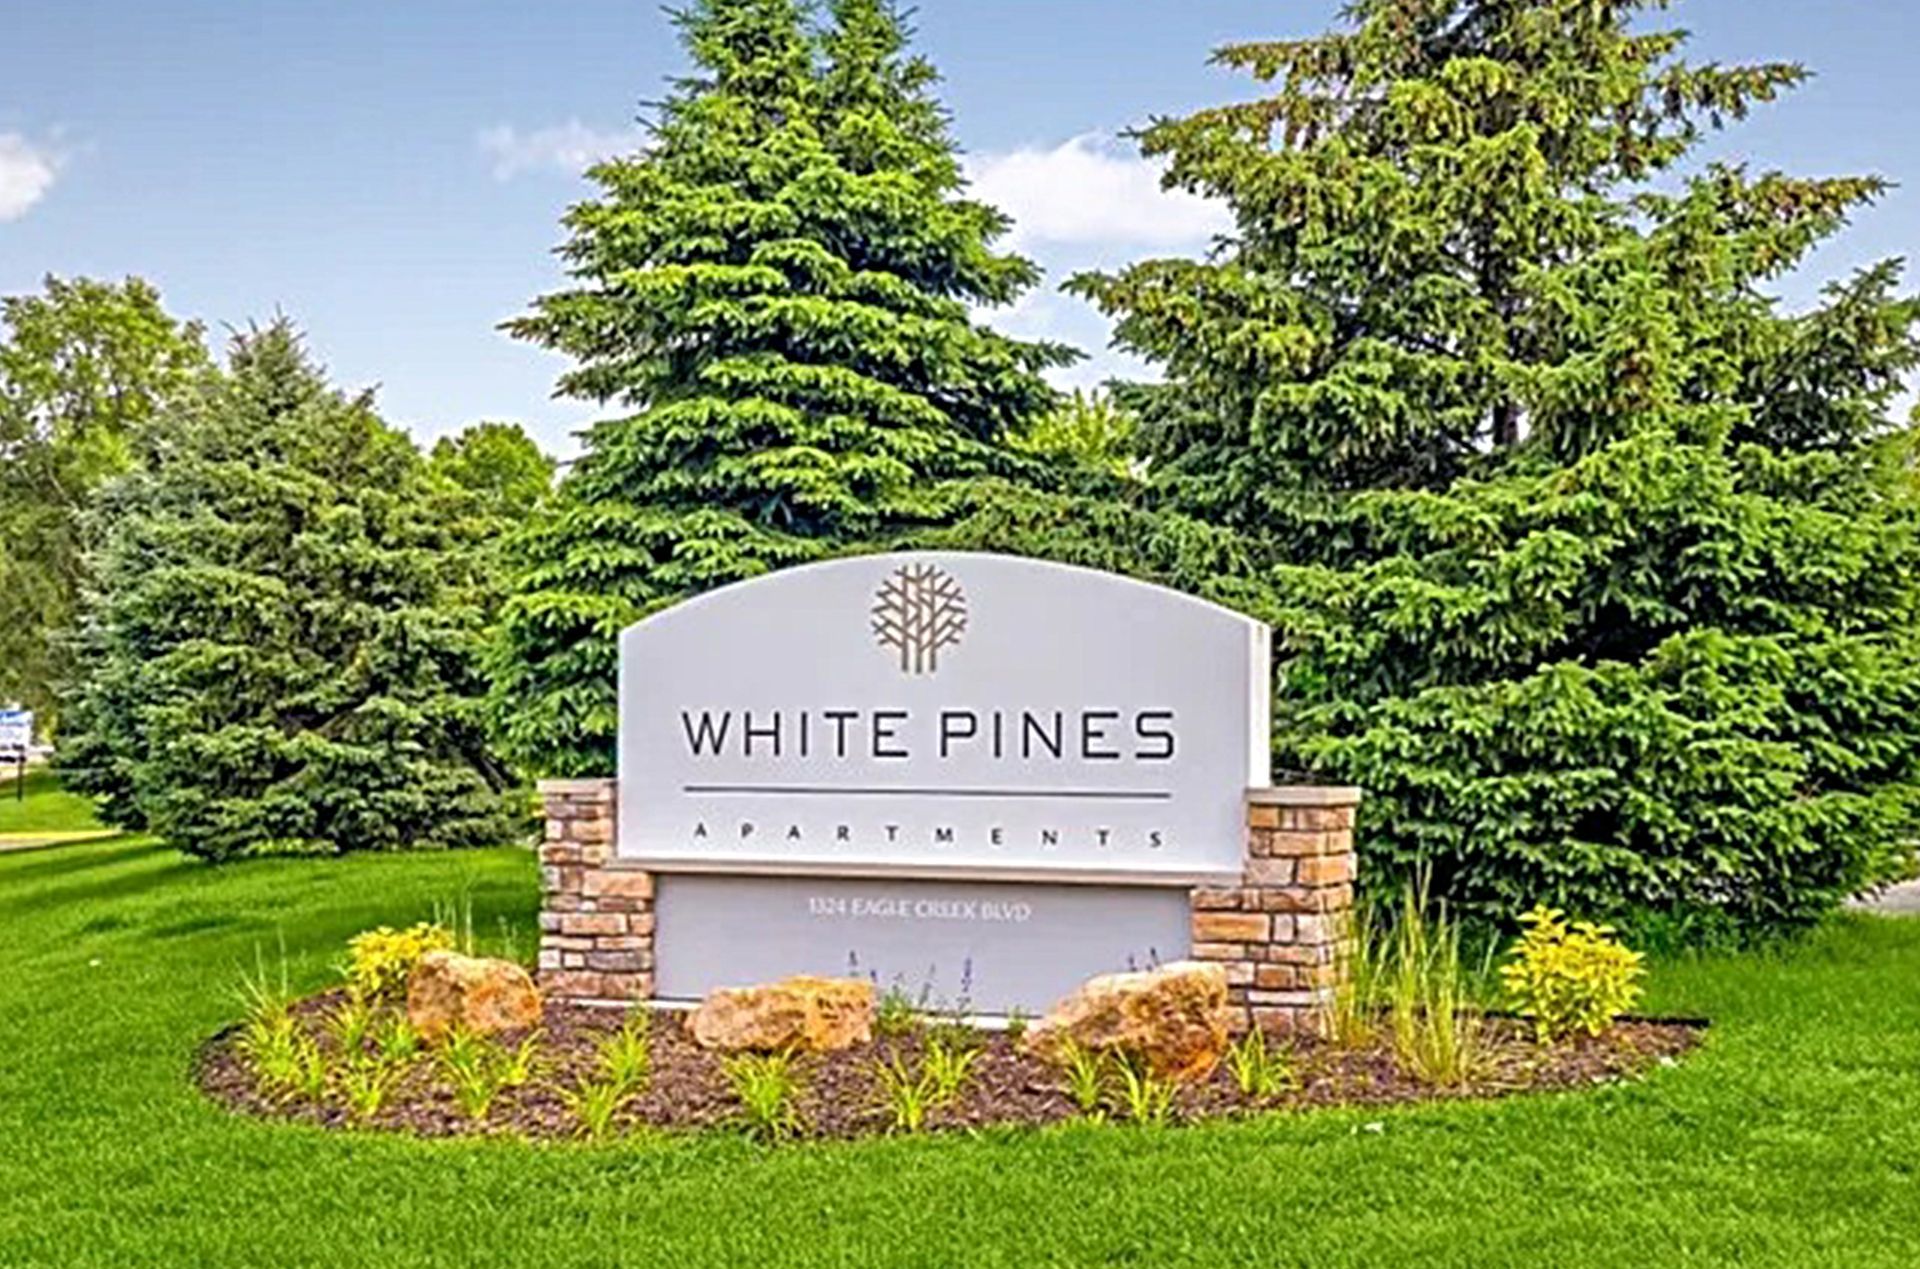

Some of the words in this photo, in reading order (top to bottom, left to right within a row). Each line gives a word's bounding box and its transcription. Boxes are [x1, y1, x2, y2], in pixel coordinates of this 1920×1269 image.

[682, 711, 908, 759] WHITE
[939, 711, 1175, 760] PINES
[694, 822, 1163, 849] APARTMENTS
[851, 898, 912, 917] EAGLE
[914, 899, 976, 919] CREEK
[981, 902, 1031, 921] BLVD
